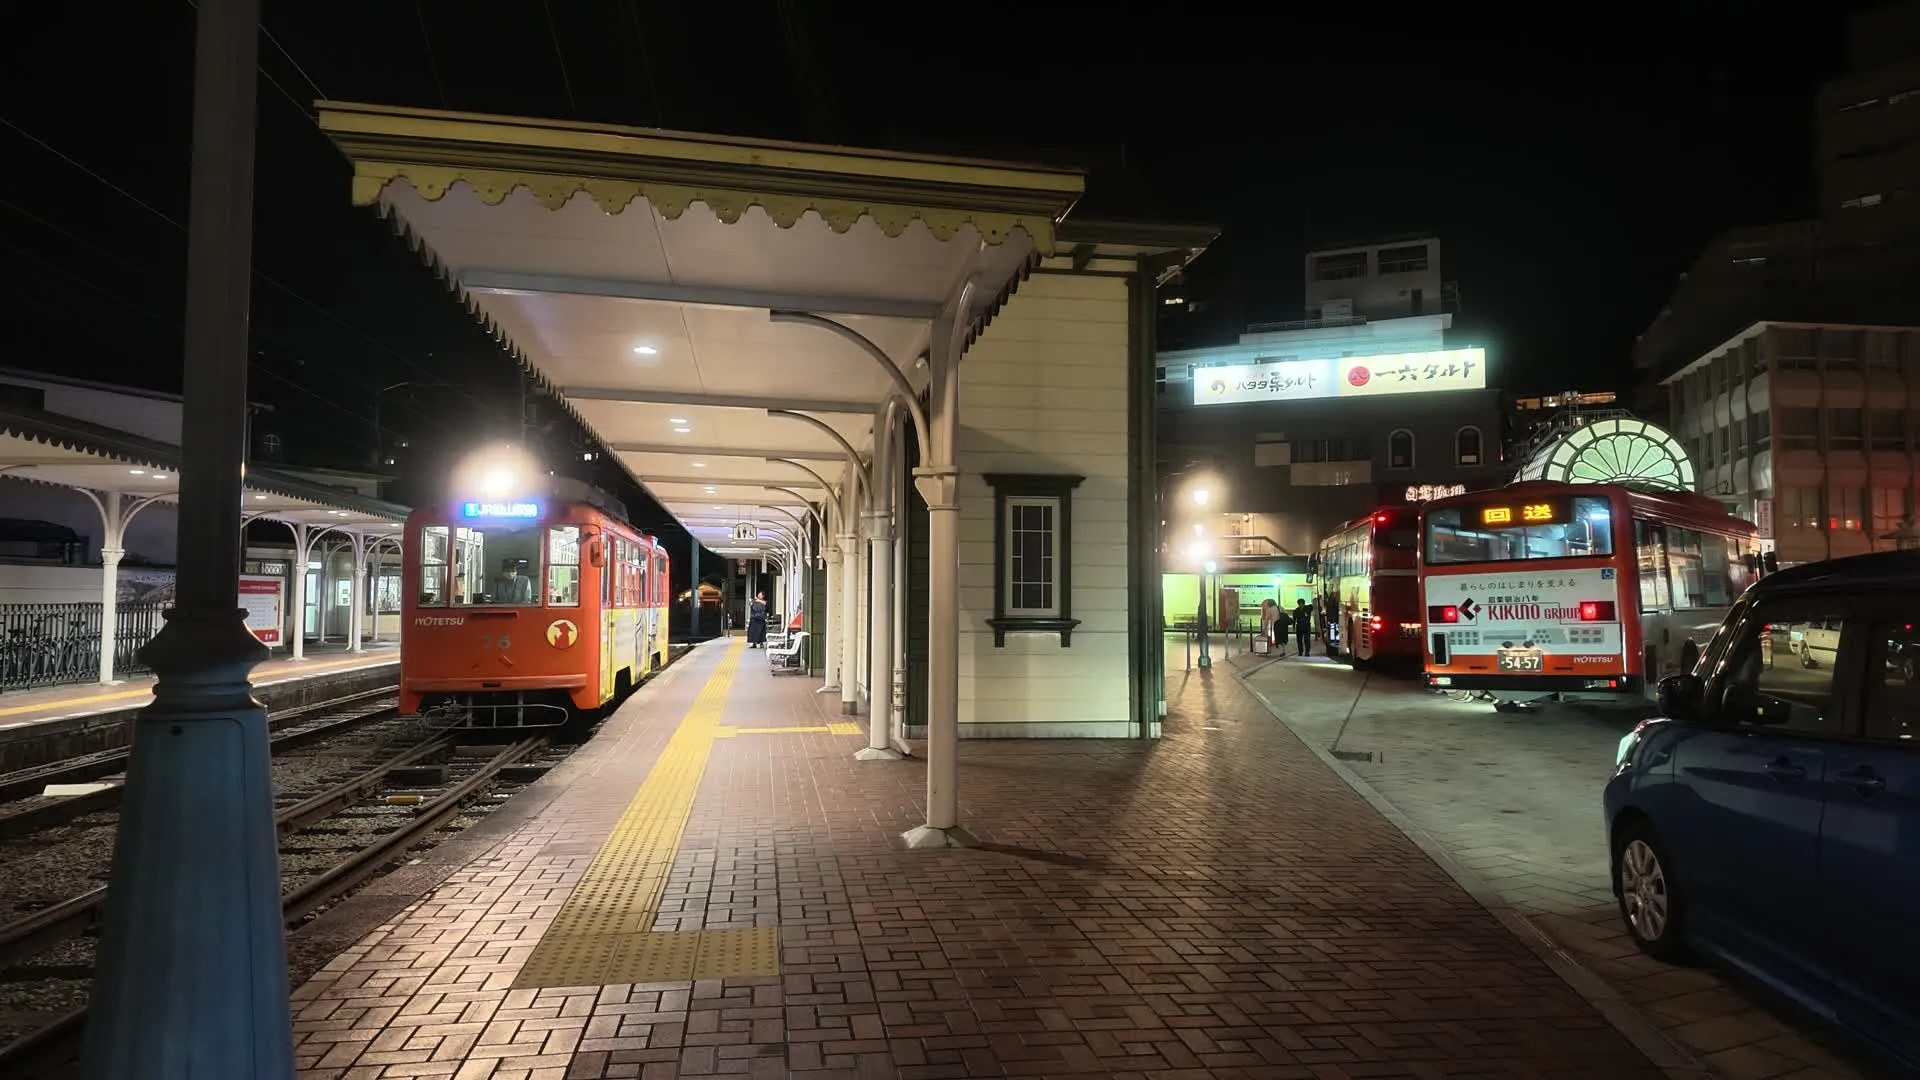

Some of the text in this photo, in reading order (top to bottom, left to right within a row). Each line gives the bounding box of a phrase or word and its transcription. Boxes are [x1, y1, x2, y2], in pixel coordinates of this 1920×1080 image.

[1483, 504, 1553, 523] 回送
[414, 616, 465, 626] IYOTETSU
[1573, 656, 1613, 664] IYOTETSU
